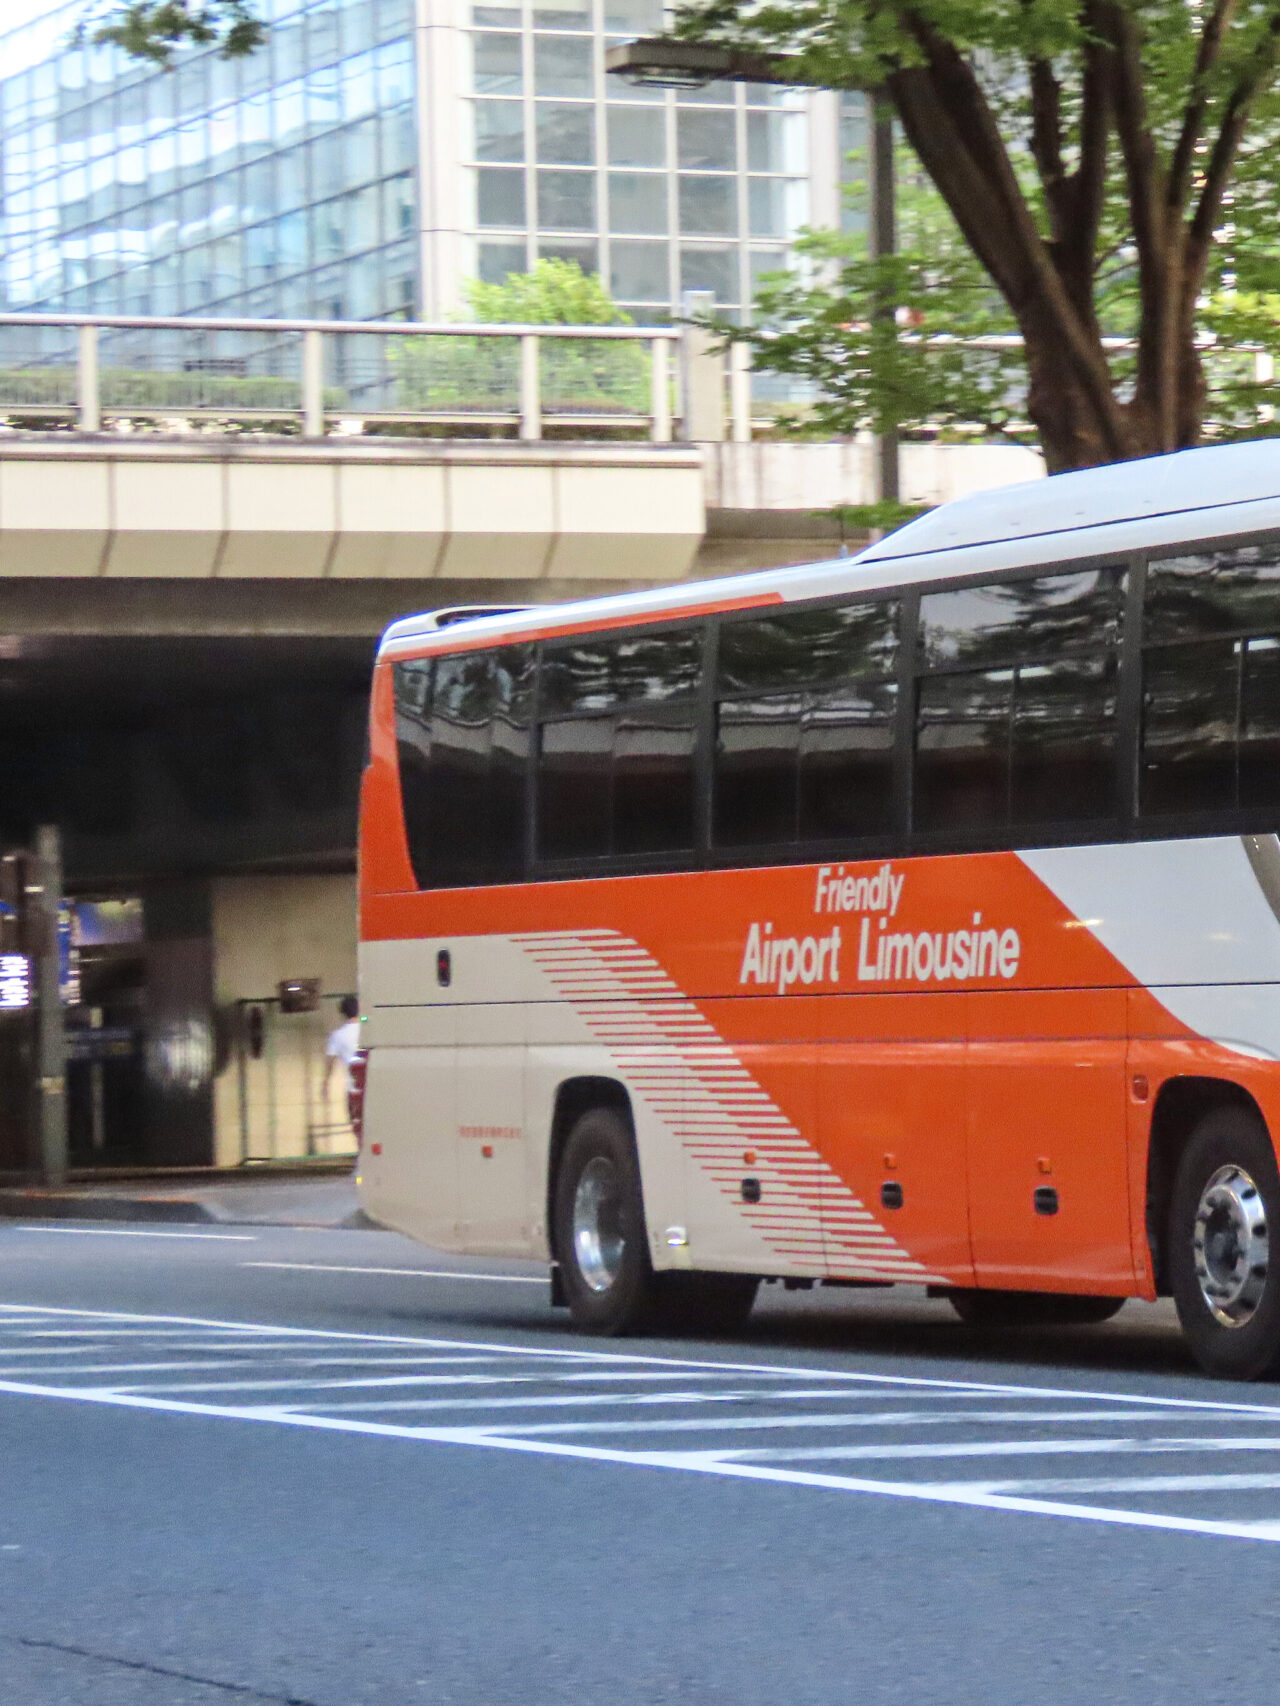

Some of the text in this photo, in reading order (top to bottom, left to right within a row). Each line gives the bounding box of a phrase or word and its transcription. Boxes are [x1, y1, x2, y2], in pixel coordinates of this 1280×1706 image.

[814, 863, 905, 916] Friendly
[739, 911, 1020, 995] Airport Limousine
